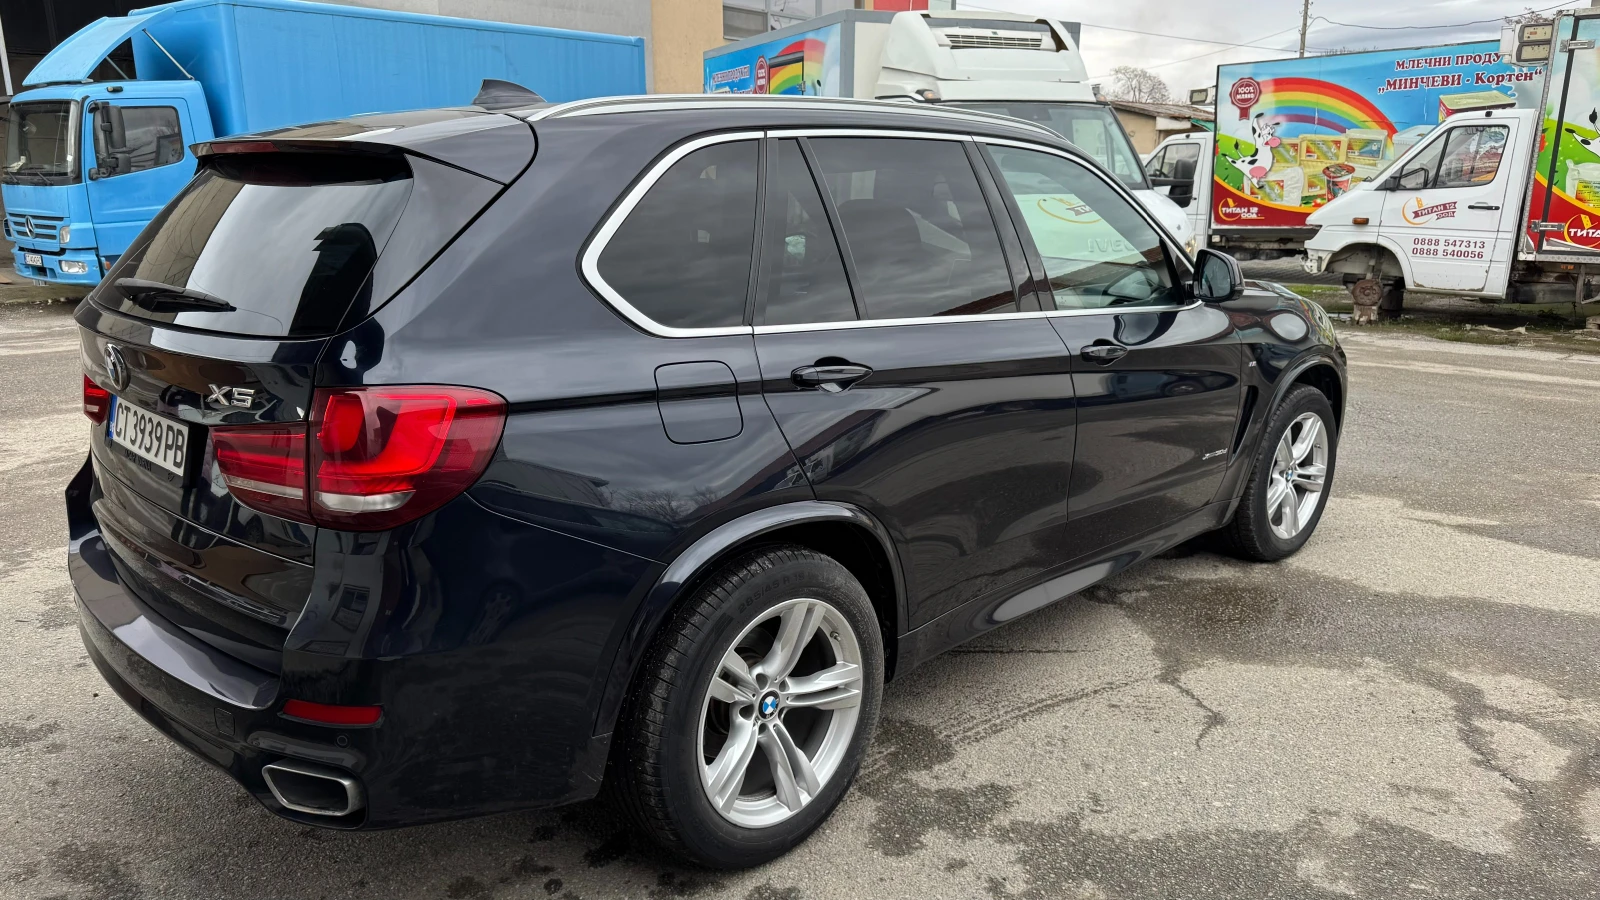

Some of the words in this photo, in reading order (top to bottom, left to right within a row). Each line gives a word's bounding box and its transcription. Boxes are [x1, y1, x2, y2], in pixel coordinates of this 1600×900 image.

[1395, 56, 1451, 70] МЛЕЧНИ
[1455, 52, 1502, 67] ПРОДУ
[1417, 205, 1444, 216] ТИТАН
[1568, 228, 1600, 238] ТИТА
[1087, 238, 1135, 253] IVEC
[1413, 237, 1440, 247] 0888
[1443, 239, 1486, 249] 547313
[1411, 247, 1439, 256] 0888
[1442, 248, 1484, 259] 540056
[205, 383, 255, 408] X5
